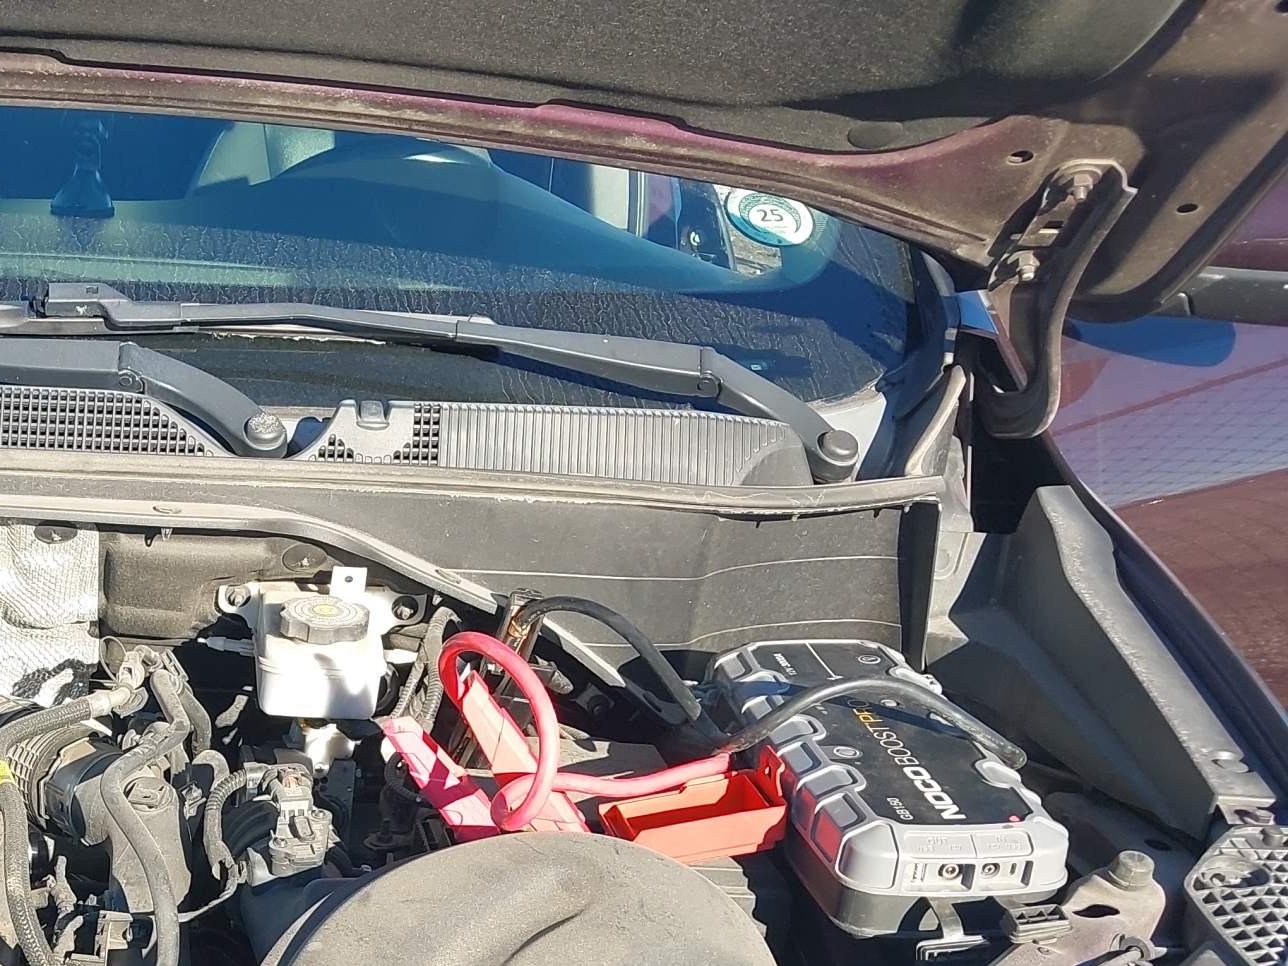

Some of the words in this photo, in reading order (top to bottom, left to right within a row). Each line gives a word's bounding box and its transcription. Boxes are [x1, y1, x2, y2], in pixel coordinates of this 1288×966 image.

[756, 208, 784, 222] 25
[902, 766, 967, 820] NOCO
[886, 797, 914, 820] GB150
